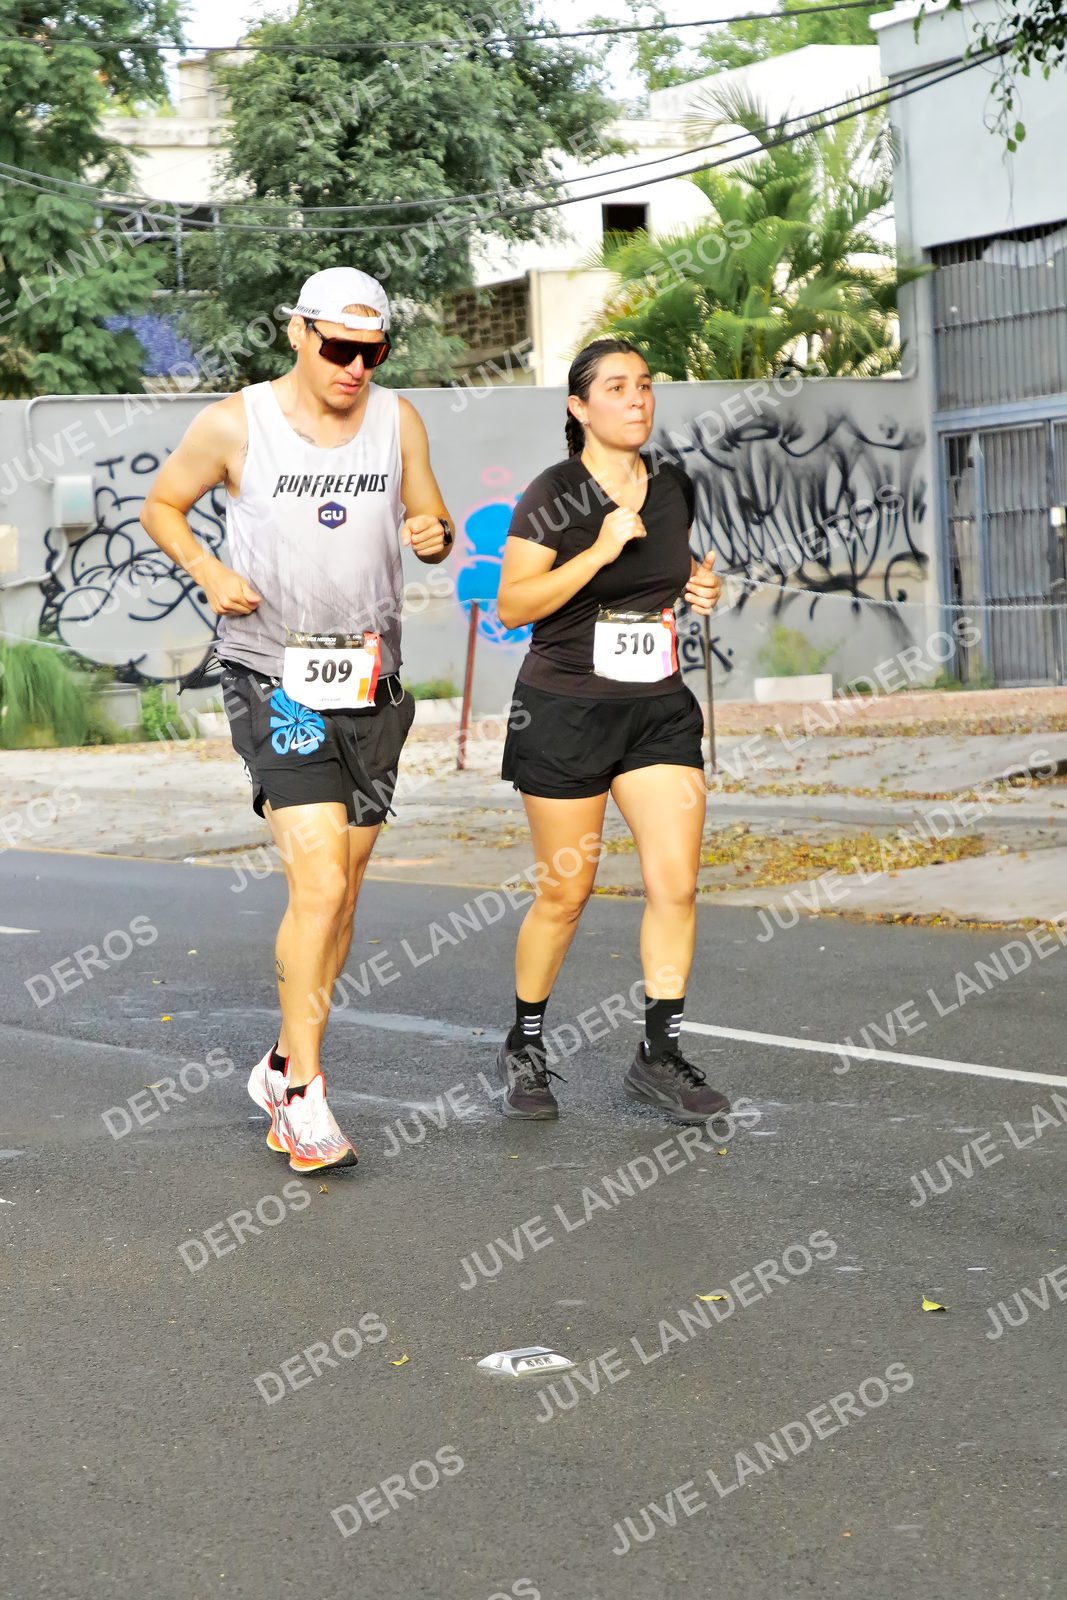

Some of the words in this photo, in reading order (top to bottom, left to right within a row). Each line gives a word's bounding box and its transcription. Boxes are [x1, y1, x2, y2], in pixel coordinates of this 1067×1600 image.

[95, 448, 172, 479] TO
[272, 474, 388, 497] RUNFREENDS
[320, 510, 344, 520] GU
[614, 632, 655, 655] 510
[304, 659, 353, 683] 509
